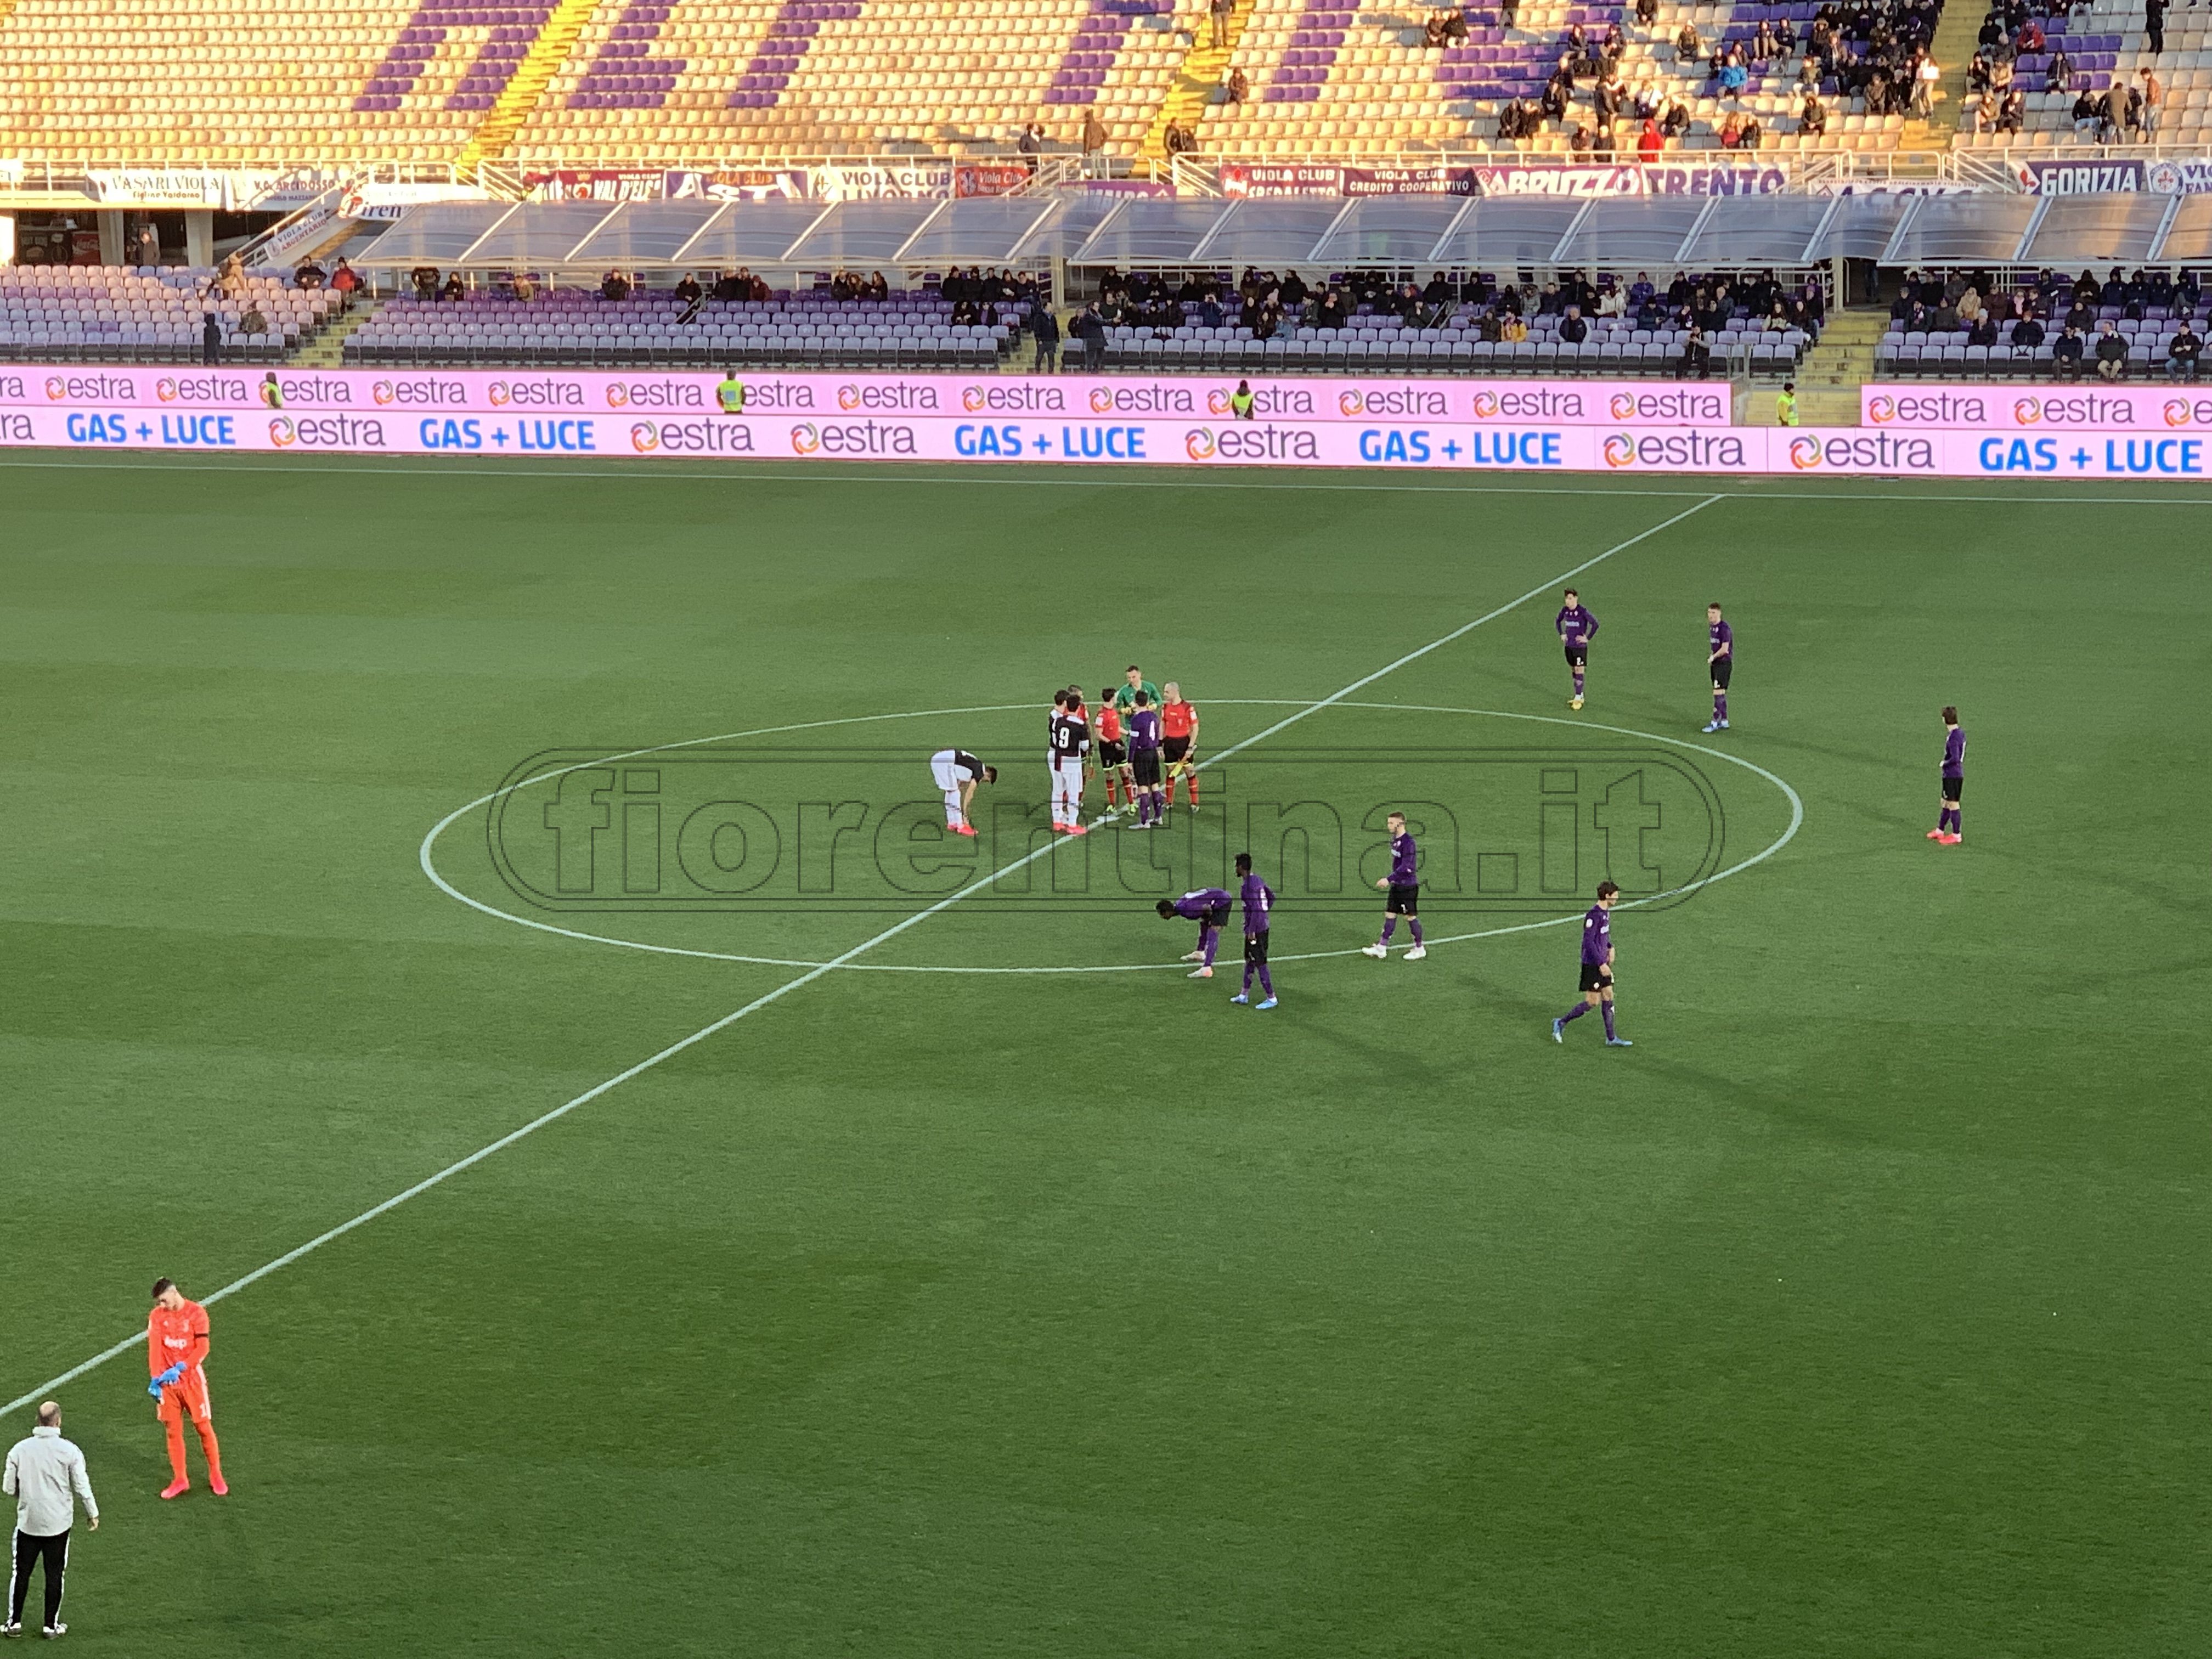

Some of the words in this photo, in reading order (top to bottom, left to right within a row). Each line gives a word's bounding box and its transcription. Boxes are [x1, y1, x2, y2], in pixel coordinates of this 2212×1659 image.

[112, 175, 170, 189] VASARI
[175, 175, 219, 190] VIOLA
[276, 179, 335, 192] ARCIDOSSO
[743, 171, 773, 184] CLUB
[842, 172, 896, 185] VIOLA
[900, 172, 950, 186] CLUB
[1252, 169, 1294, 182] VIOLA
[1298, 169, 1335, 181] CLUB
[1350, 181, 1394, 193] CREDITO
[1399, 180, 1469, 192] COOPERATIVO
[1374, 171, 1409, 180] VIOLA
[1416, 168, 1446, 180] CLUB
[1488, 168, 1640, 197] ABRUZZO
[1646, 169, 1786, 196] TRENTO
[2041, 166, 2137, 195] GORIZIA
[278, 225, 302, 242] VIOLA
[68, 374, 136, 399] estra
[179, 375, 248, 400] estra
[281, 376, 352, 402] estra
[396, 377, 467, 403] estra
[512, 379, 584, 404] estra
[630, 380, 704, 406] estra
[744, 380, 815, 408] estra
[862, 381, 939, 409] estra
[988, 382, 1065, 410] estra
[1115, 383, 1195, 411] estra
[1254, 385, 1315, 414] stra
[1374, 386, 1448, 415] estra
[1500, 388, 1584, 417] estra
[1638, 390, 1723, 419] estra
[1897, 392, 1987, 422] estra
[2044, 393, 2135, 424] estra
[66, 413, 127, 443] GAS
[136, 422, 153, 439] +
[162, 415, 235, 445] LUCE
[297, 413, 386, 446] estra
[420, 419, 482, 449] GAS
[491, 427, 509, 446] +
[518, 420, 595, 450] LUCE
[661, 417, 755, 451] estra
[822, 420, 918, 454] estra
[955, 425, 1022, 456] GAS
[1032, 433, 1052, 454] +
[1063, 427, 1146, 458] LUCE
[1217, 424, 1320, 459] estra
[1359, 430, 1430, 462] GAS
[1441, 439, 1462, 461] +
[1474, 432, 1561, 465] LUCE
[1638, 430, 1746, 466] estra
[1825, 431, 1936, 469] estra
[1979, 438, 2058, 471] GAS
[2070, 447, 2092, 469] +
[2106, 439, 2202, 473] LUCE
